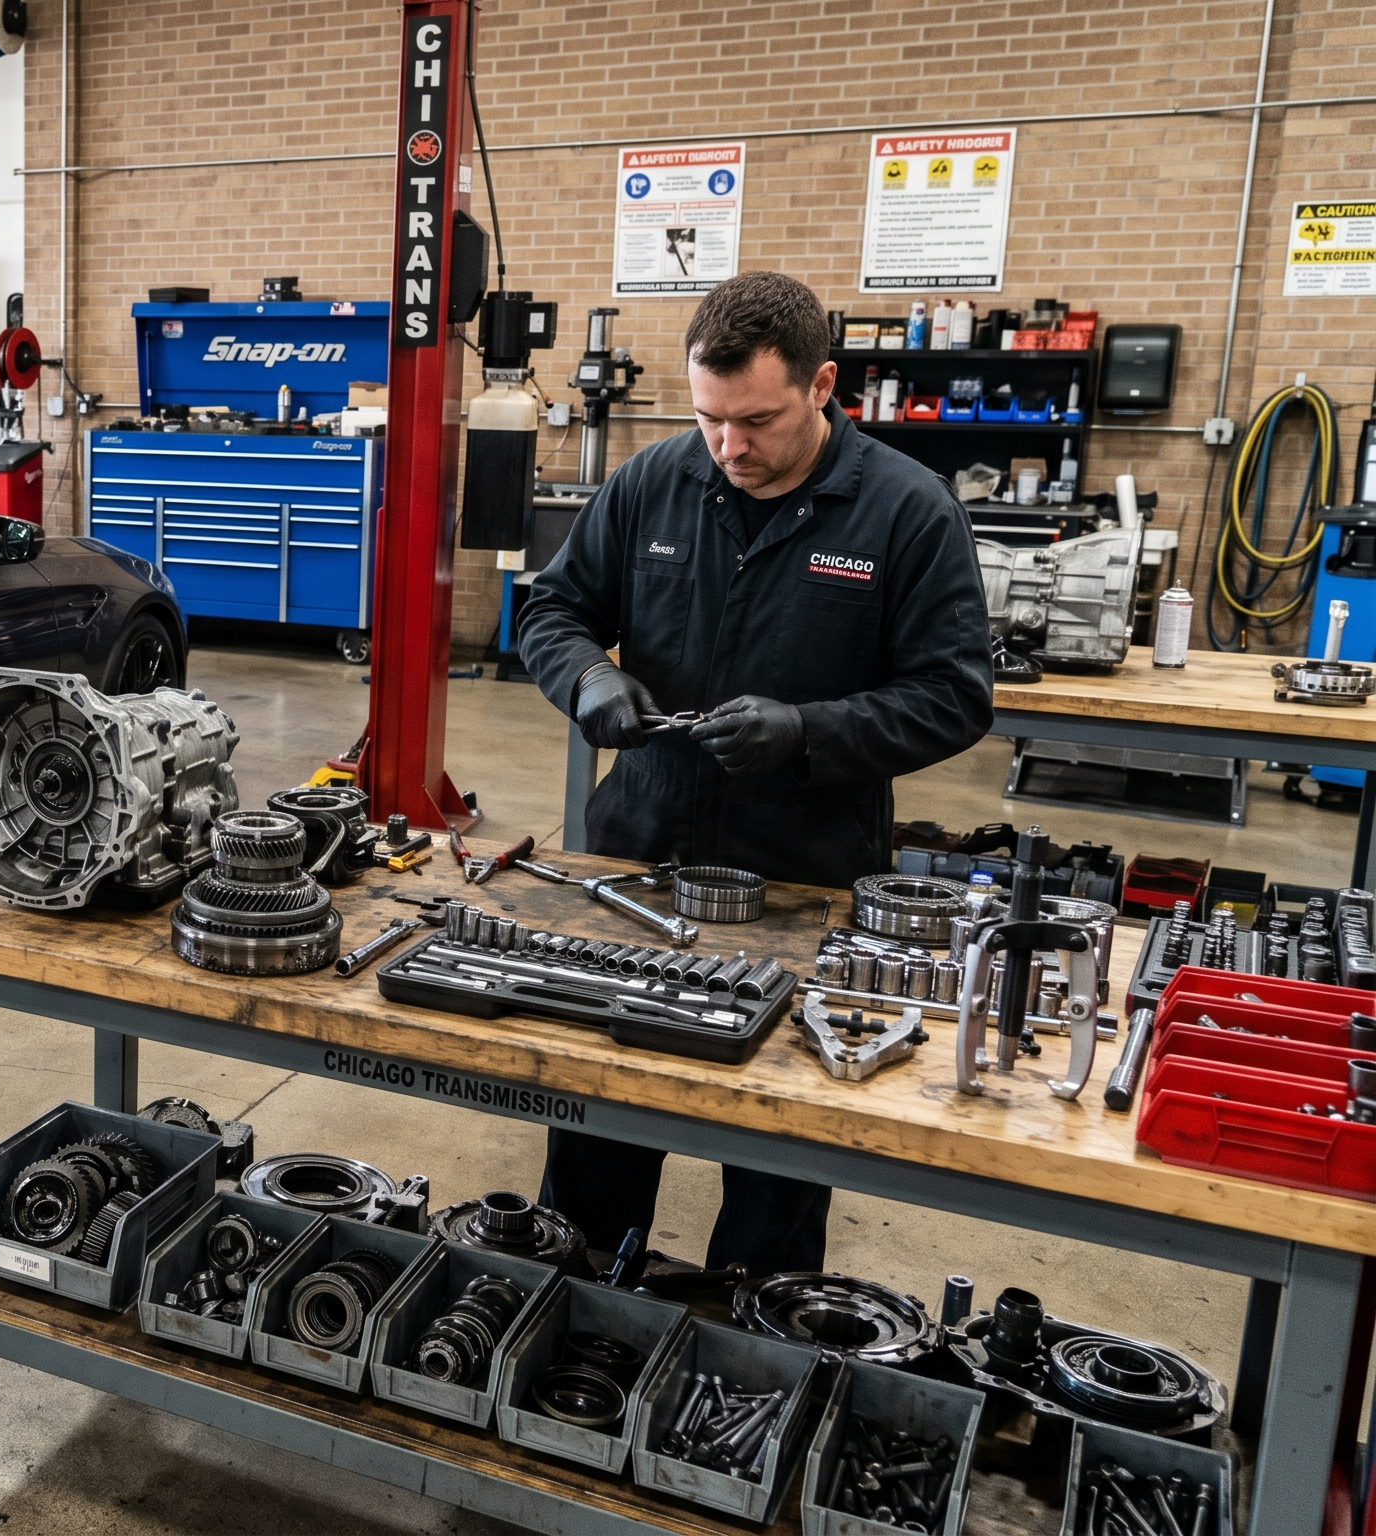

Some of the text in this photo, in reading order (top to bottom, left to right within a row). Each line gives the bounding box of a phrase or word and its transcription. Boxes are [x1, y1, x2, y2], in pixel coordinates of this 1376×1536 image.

[896, 139, 945, 152] SAFETY
[405, 24, 441, 339] CHI TRANS
[203, 336, 346, 367] Snap-on
[810, 553, 874, 572] CHICAGO
[324, 1050, 585, 1125] CHICAGO TRANSMISSION
